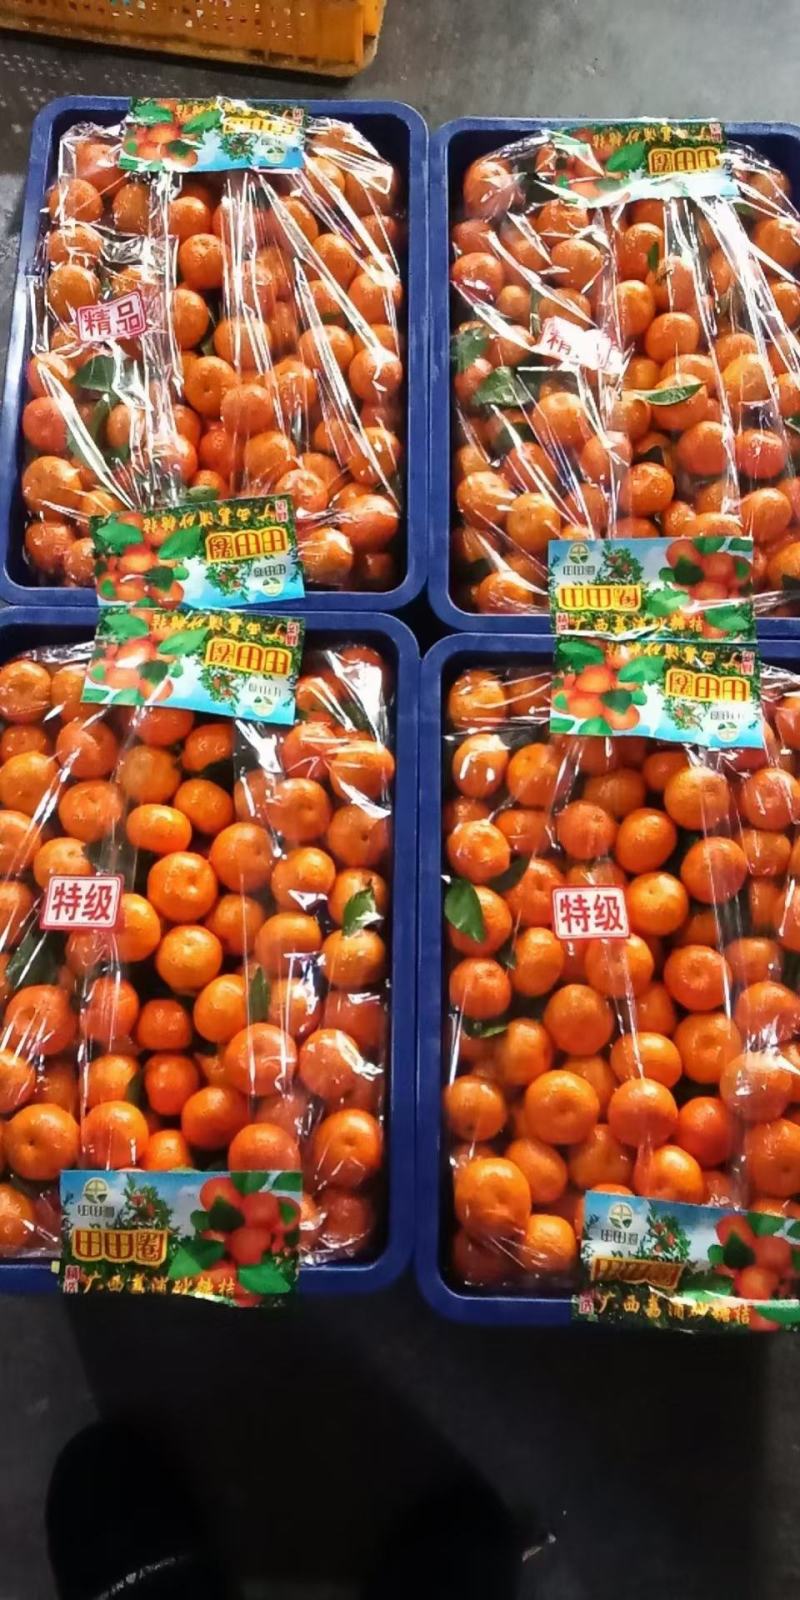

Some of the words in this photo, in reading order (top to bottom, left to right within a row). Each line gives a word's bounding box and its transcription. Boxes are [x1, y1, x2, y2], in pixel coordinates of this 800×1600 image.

[84, 301, 140, 336] 精品
[207, 527, 288, 561] 田田圈
[205, 638, 292, 675] 田田圈
[666, 668, 749, 701] 田田圈
[52, 883, 112, 920] 特级
[560, 894, 623, 933] 特级
[72, 1229, 168, 1267] 田田圈
